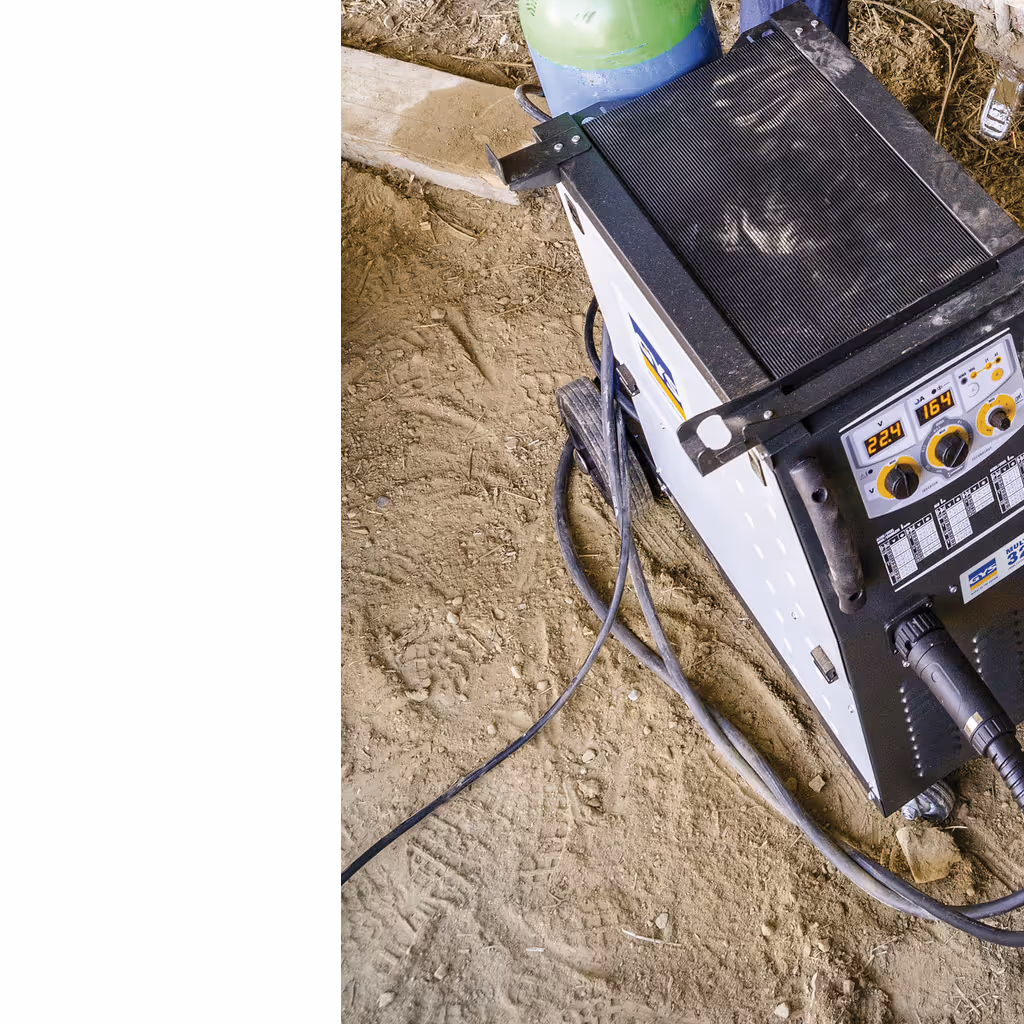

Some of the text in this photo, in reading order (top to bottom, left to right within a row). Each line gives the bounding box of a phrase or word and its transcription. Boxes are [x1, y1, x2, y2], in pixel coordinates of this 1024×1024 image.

[923, 390, 952, 420] 164
[867, 421, 902, 455] 22.4
[969, 561, 997, 586] GYS
